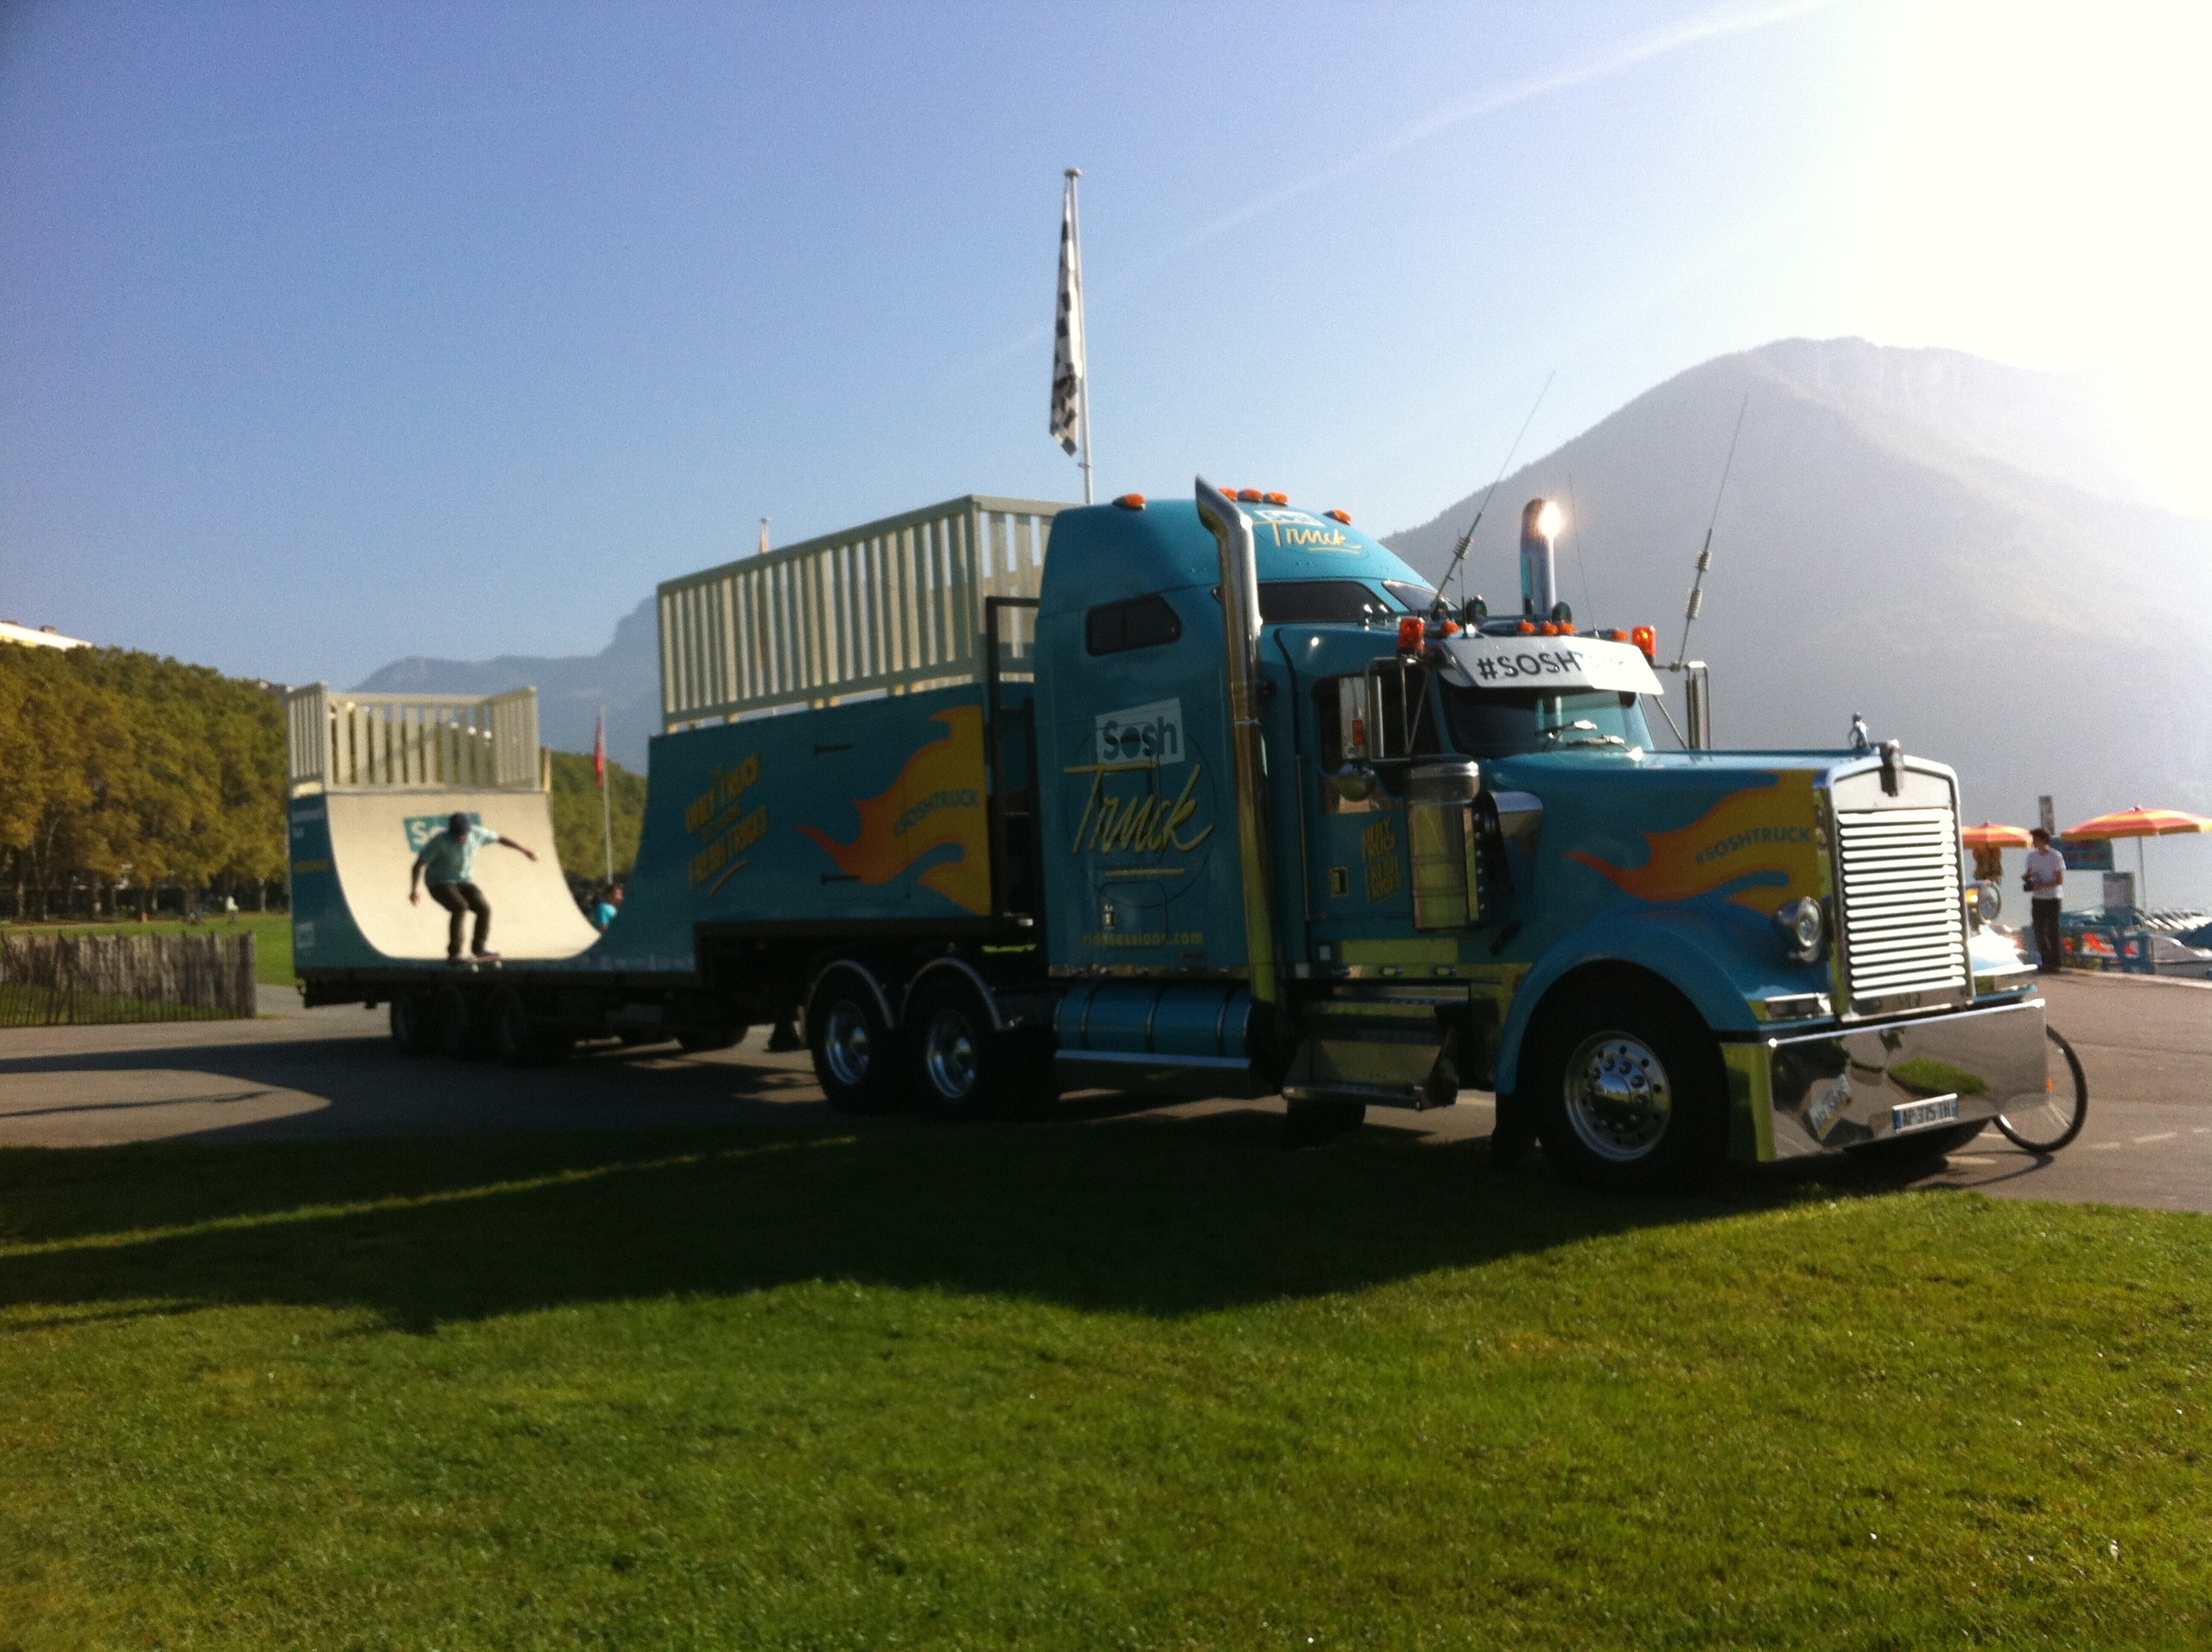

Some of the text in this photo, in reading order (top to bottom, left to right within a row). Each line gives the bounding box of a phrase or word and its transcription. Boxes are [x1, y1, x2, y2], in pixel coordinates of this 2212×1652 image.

[1254, 520, 1360, 549] Truck
[1477, 650, 1625, 680] #SOSH
[1063, 760, 1217, 854] Truck
